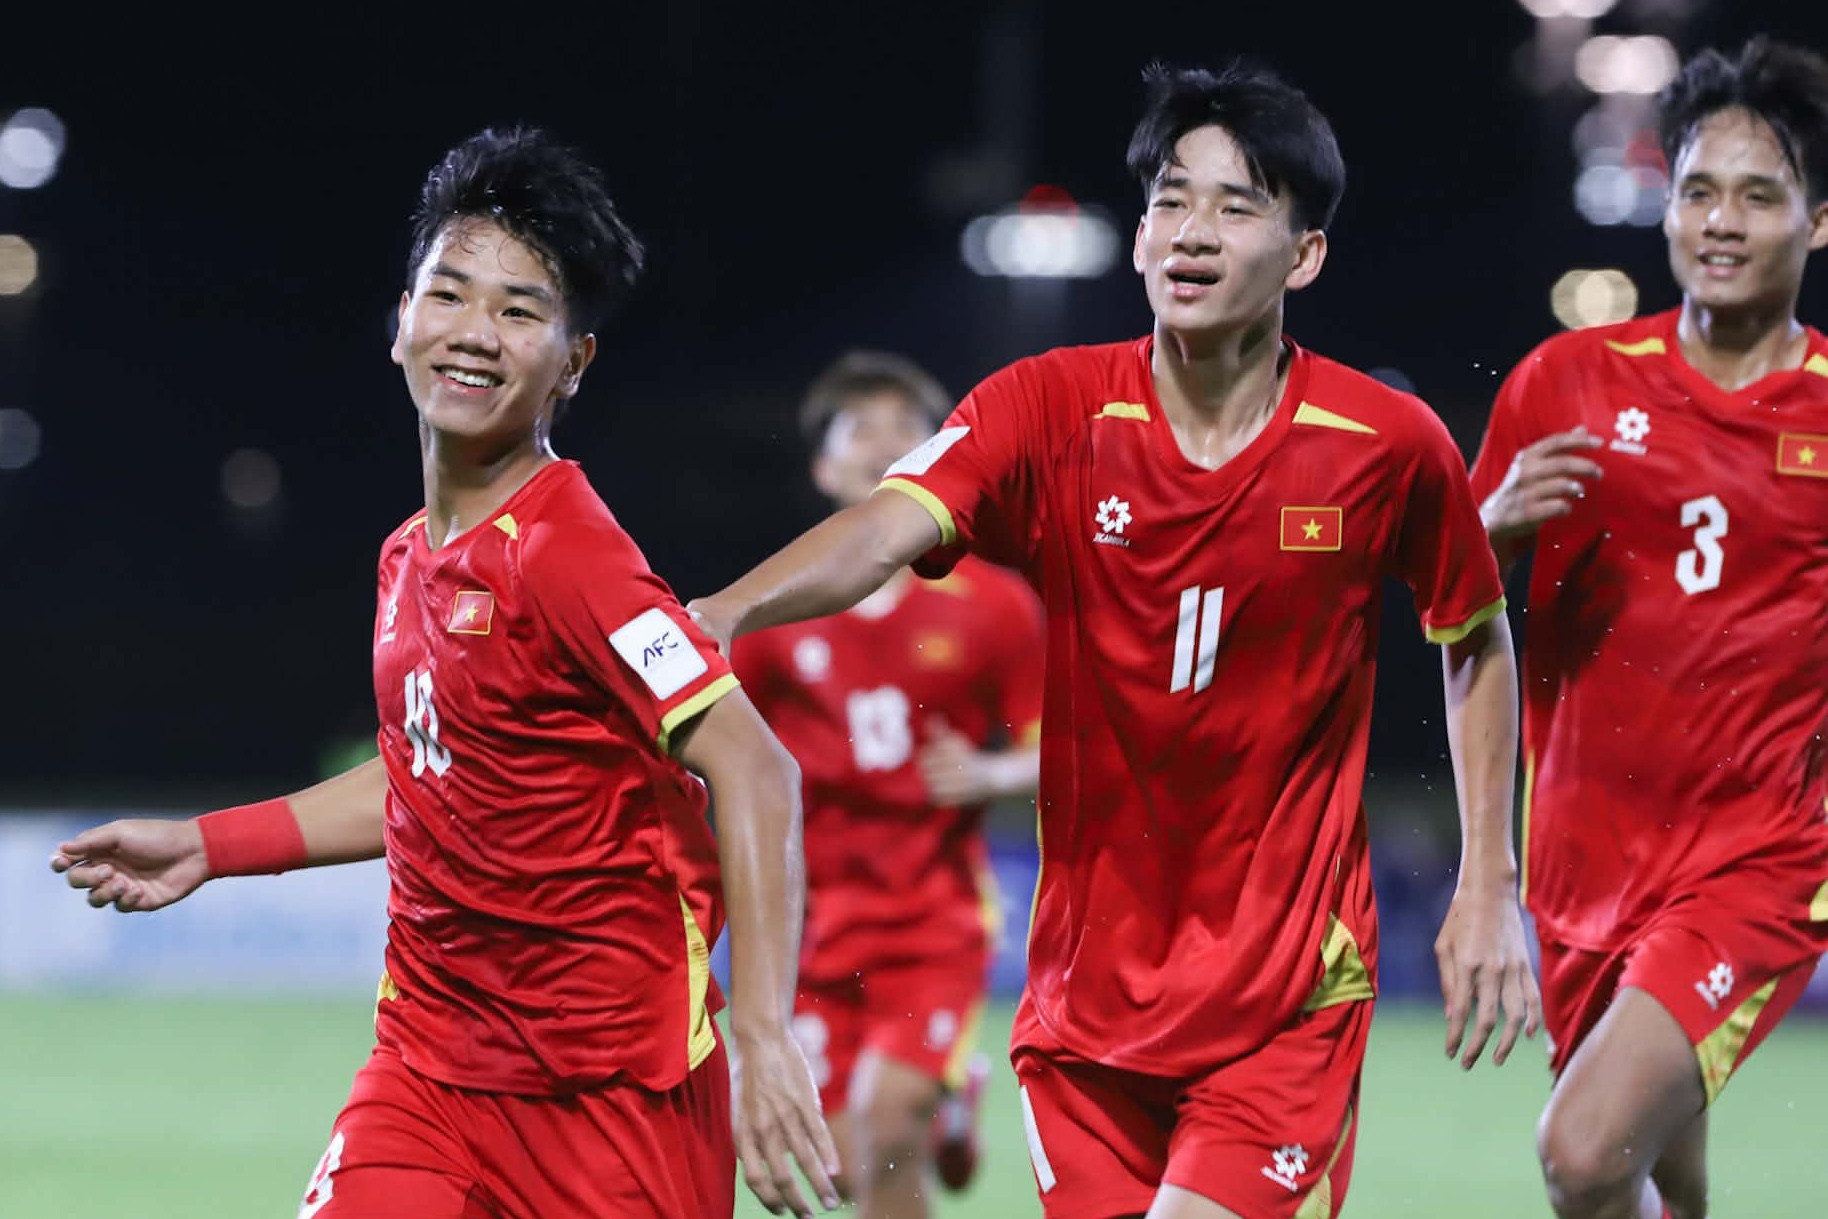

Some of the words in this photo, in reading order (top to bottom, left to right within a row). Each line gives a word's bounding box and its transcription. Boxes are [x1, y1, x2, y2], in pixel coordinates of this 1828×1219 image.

[1675, 494, 1729, 596] 3
[643, 631, 680, 668] AFC
[1169, 584, 1225, 694] 11
[403, 668, 453, 779] 10
